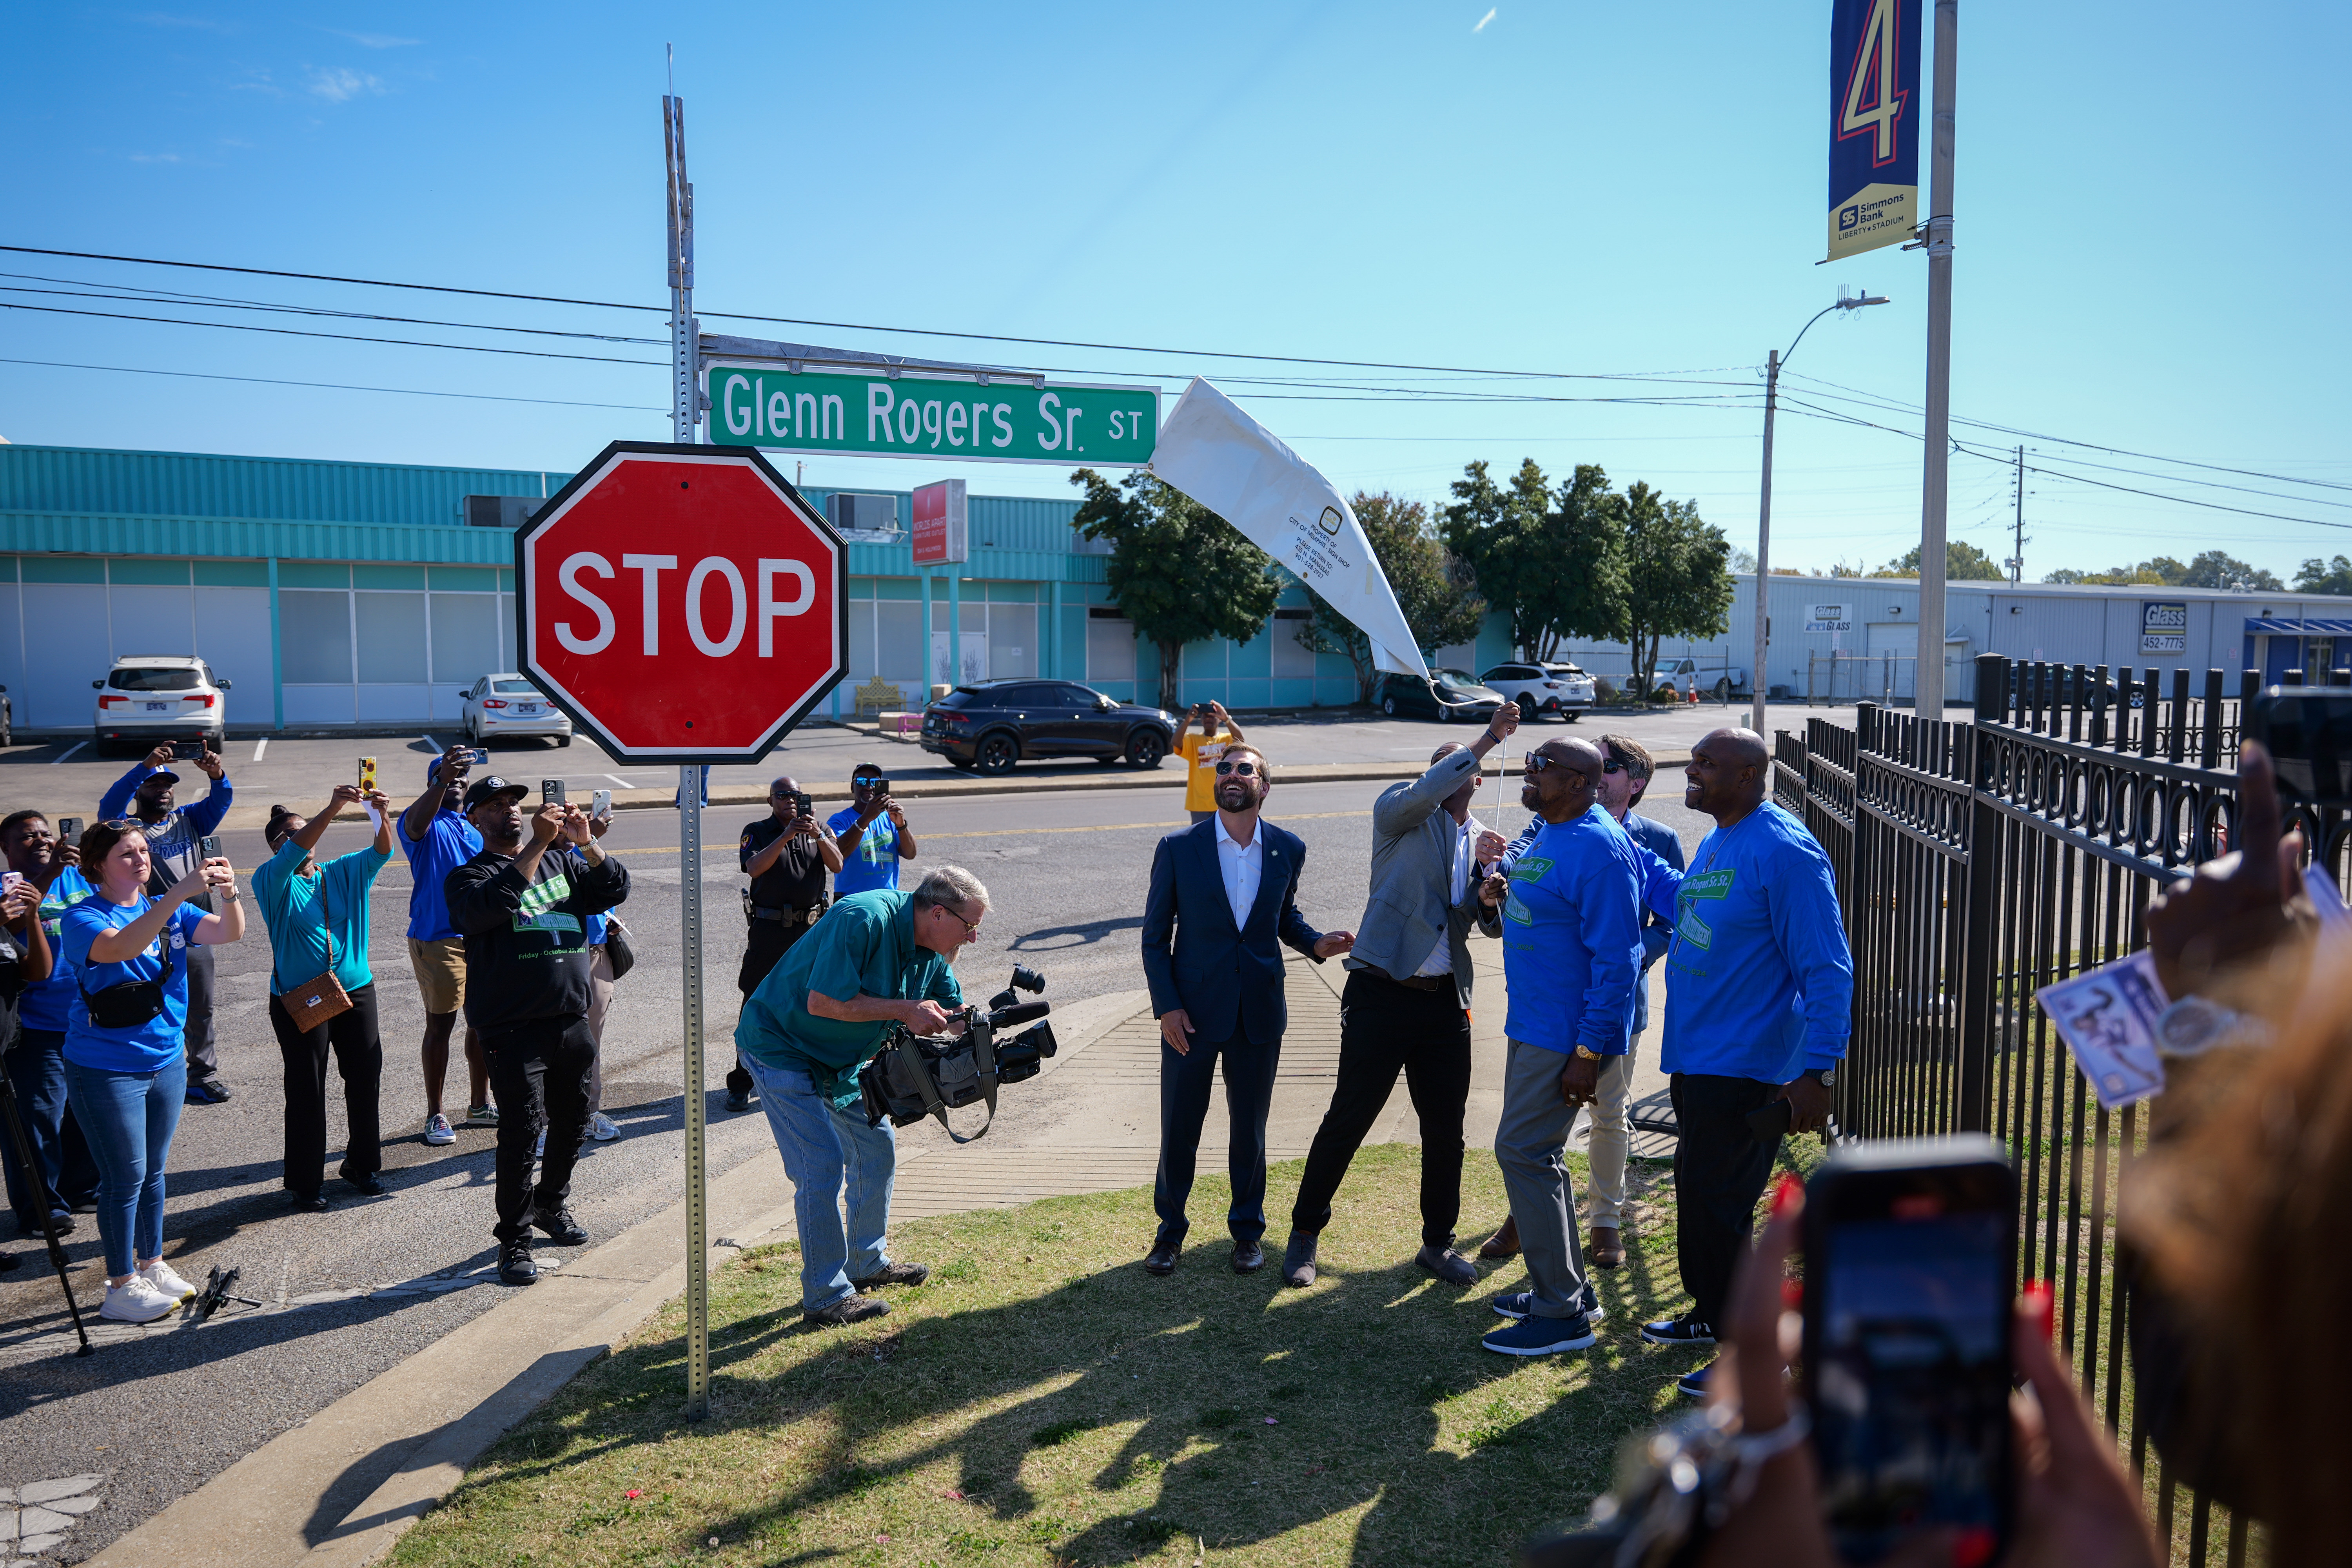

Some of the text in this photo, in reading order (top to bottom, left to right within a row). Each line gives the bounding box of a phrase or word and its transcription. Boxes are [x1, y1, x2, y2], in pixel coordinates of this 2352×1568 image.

[1838, 0, 1908, 169] 4
[1860, 194, 1904, 213] Simmons
[1860, 209, 1884, 224] Bank
[1839, 216, 1904, 240] LIBERTY STADIUM
[724, 374, 1142, 452] Glenn Rogers Sr. ST
[1289, 517, 1300, 526] CITY
[1307, 530, 1326, 548] MEMPHIS
[1328, 548, 1338, 559] SIGN
[1338, 557, 1350, 568] SHOP
[1310, 524, 1331, 543] PROPERTY
[1296, 537, 1311, 551] PLEASE
[1311, 549, 1326, 564] RETURN
[1295, 553, 1324, 579] 901-528-2937
[1309, 555, 1330, 576] MANASSAS
[554, 551, 815, 658] STOP
[1816, 606, 1840, 615] Glass
[2145, 604, 2185, 625] Glass
[1826, 621, 1851, 631] GLASS
[1532, 862, 1545, 873] St.
[555, 879, 566, 889] St.
[1690, 878, 1710, 892] Rogers
[1708, 875, 1718, 887] Sr.
[1717, 874, 1728, 886] St.
